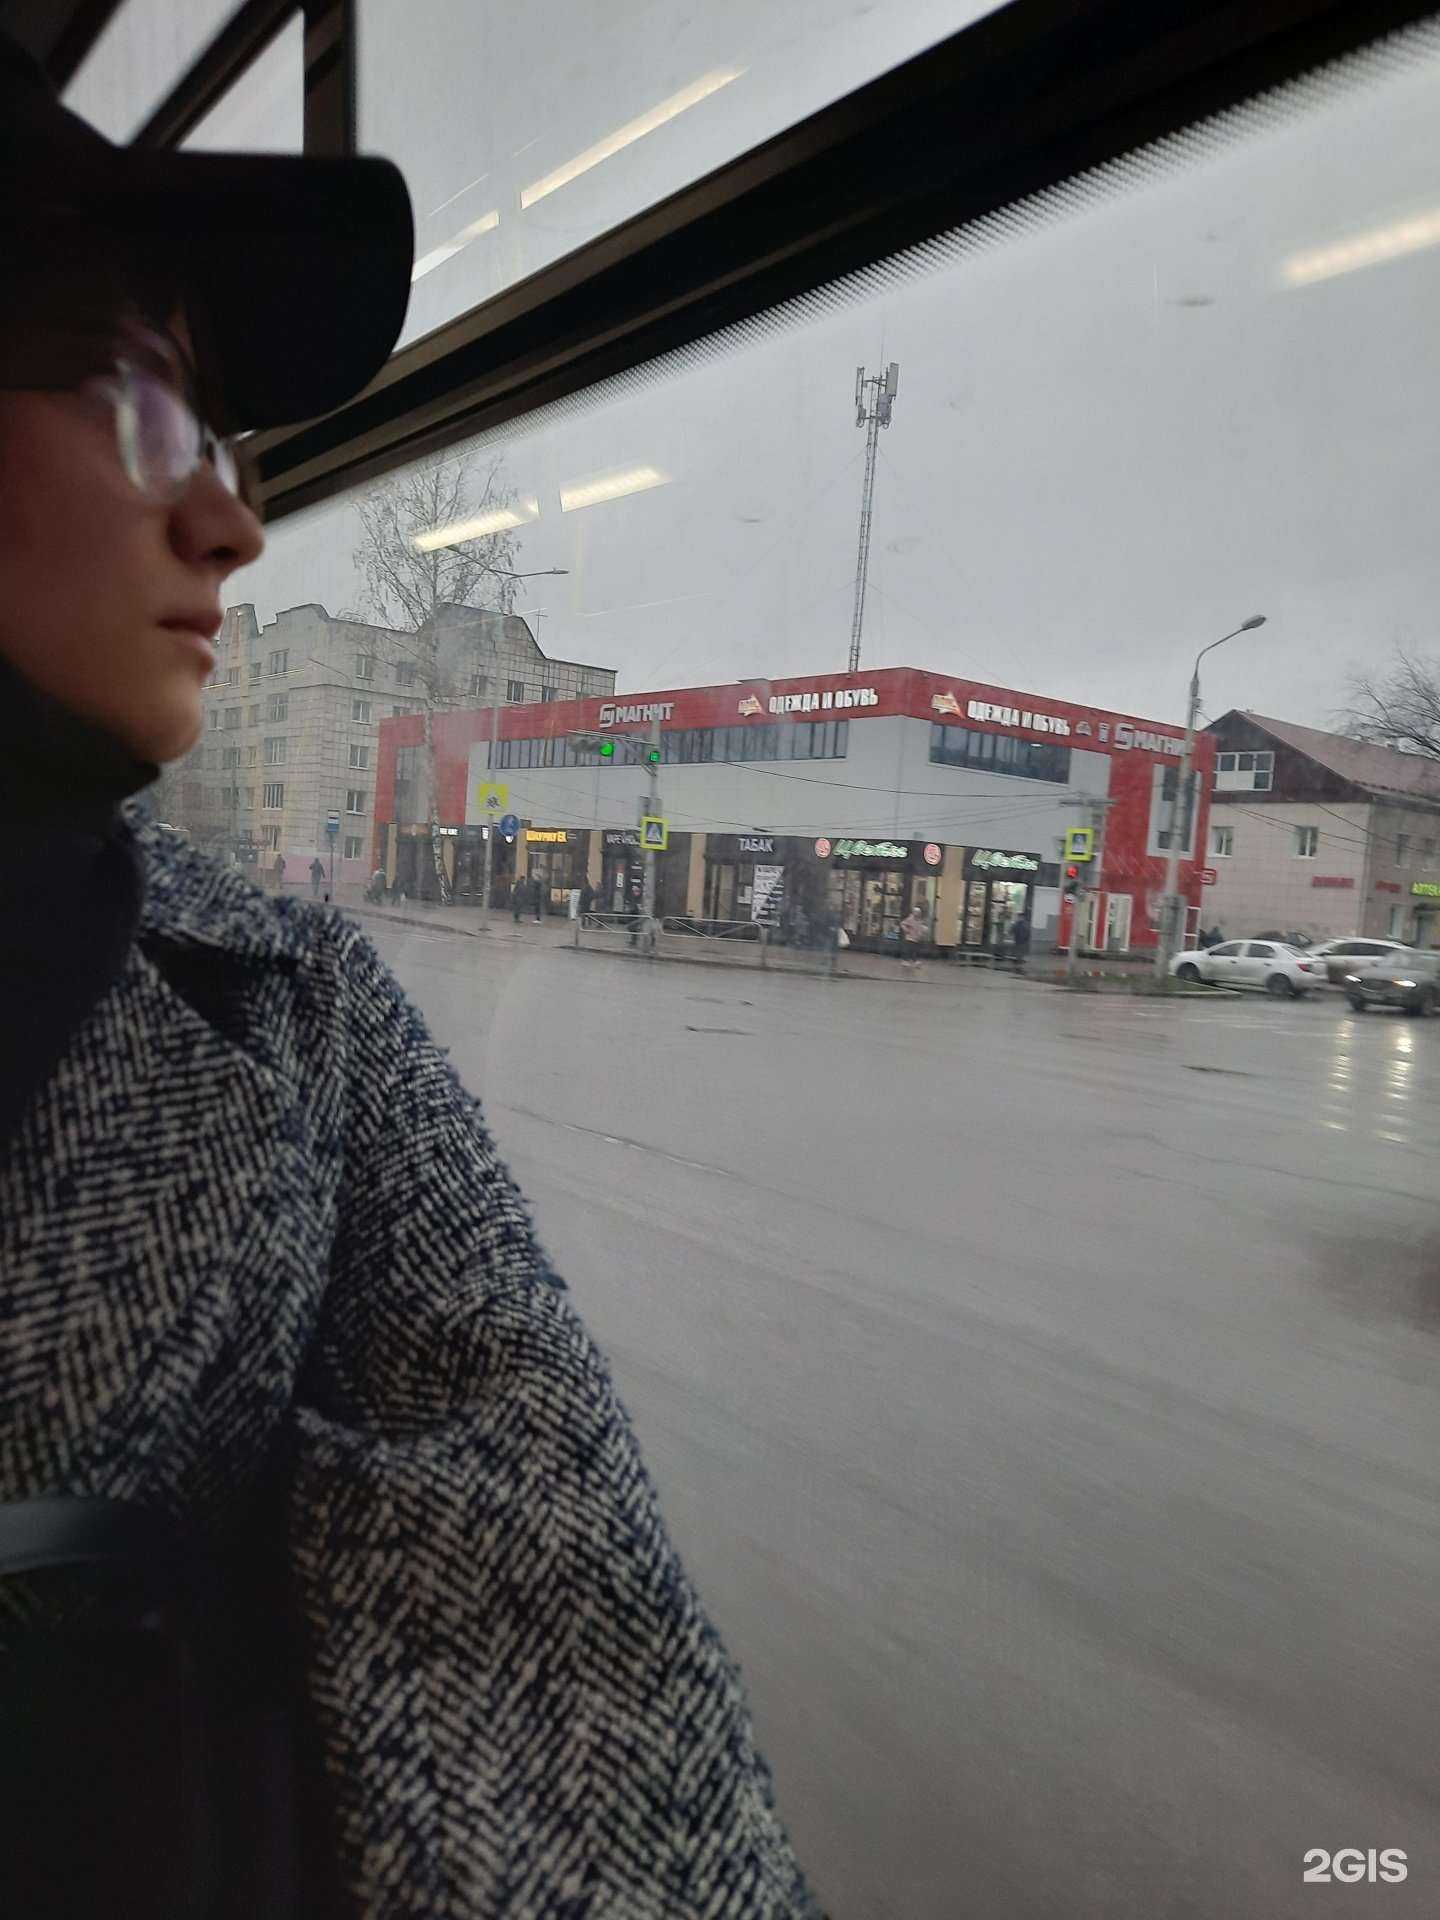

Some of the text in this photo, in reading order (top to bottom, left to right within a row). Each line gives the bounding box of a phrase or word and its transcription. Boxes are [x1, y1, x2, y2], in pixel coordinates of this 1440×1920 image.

[769, 693, 820, 715] ОДЕЖДА
[822, 692, 833, 709] И
[834, 688, 879, 709] ОБУВЬ
[967, 700, 1020, 727] ОДЕЖДА
[738, 838, 774, 852] ТАБАК
